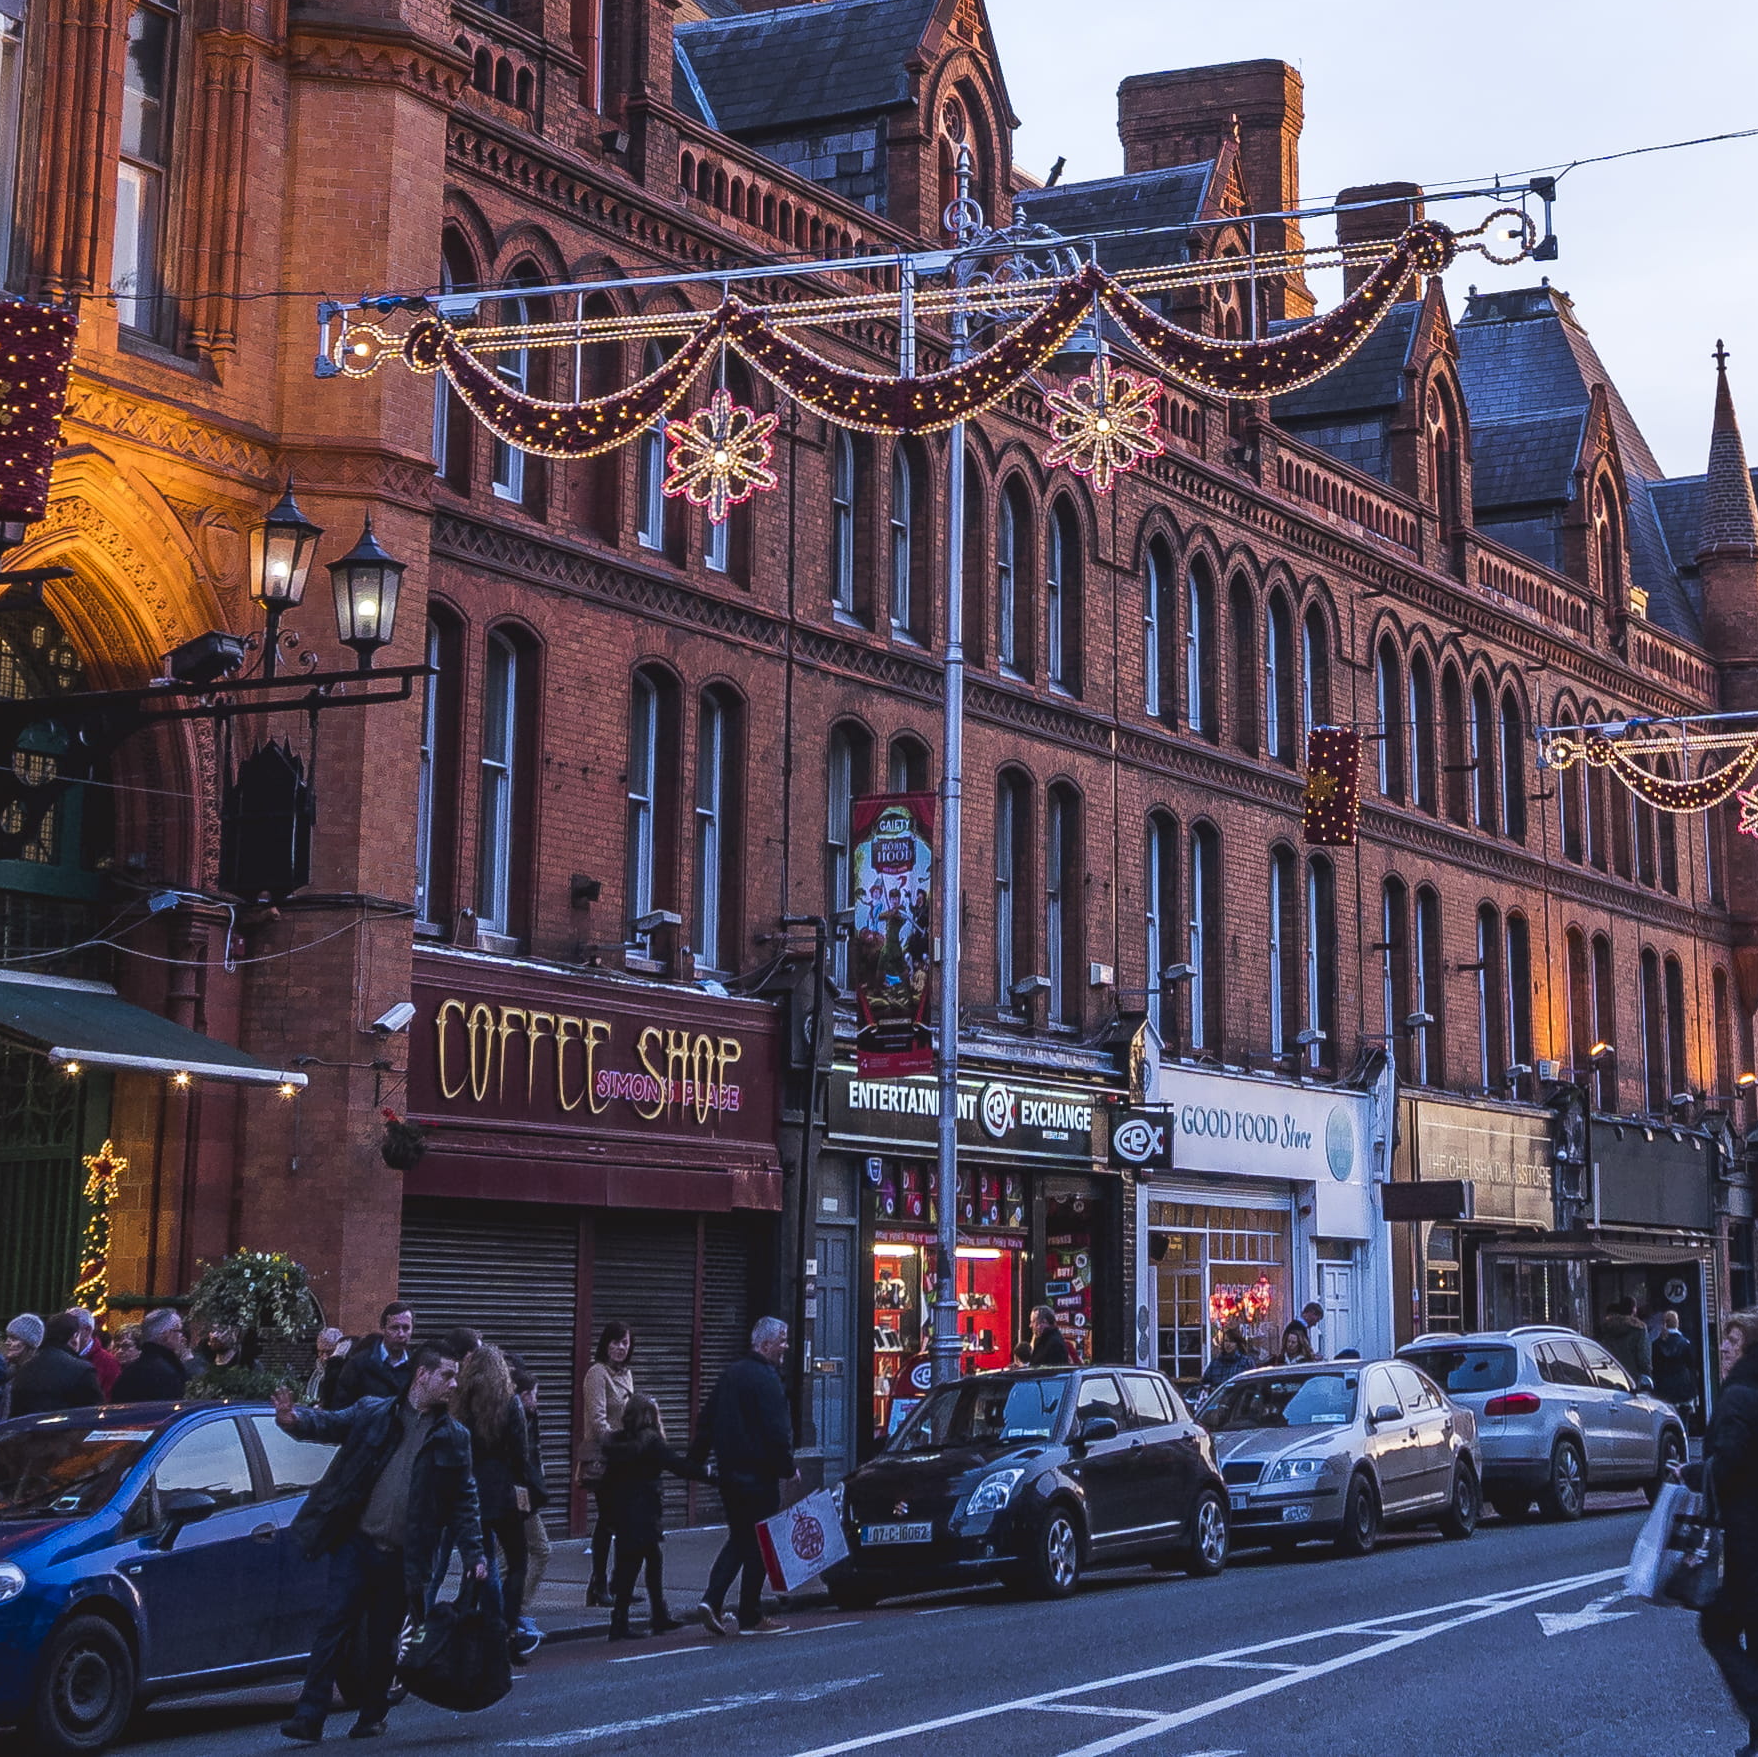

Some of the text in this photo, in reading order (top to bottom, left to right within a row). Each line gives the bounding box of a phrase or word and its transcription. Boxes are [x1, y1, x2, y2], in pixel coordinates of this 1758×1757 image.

[879, 818, 910, 831] GAIETY
[877, 850, 912, 863] HOOD
[881, 843, 909, 853] ROBIN
[436, 999, 741, 1125] COFFEE SHOP
[683, 1080, 740, 1111] PLACE
[1021, 1100, 1092, 1131] EXCHANGE
[1181, 1104, 1312, 1149] GOOD FOOD Store
